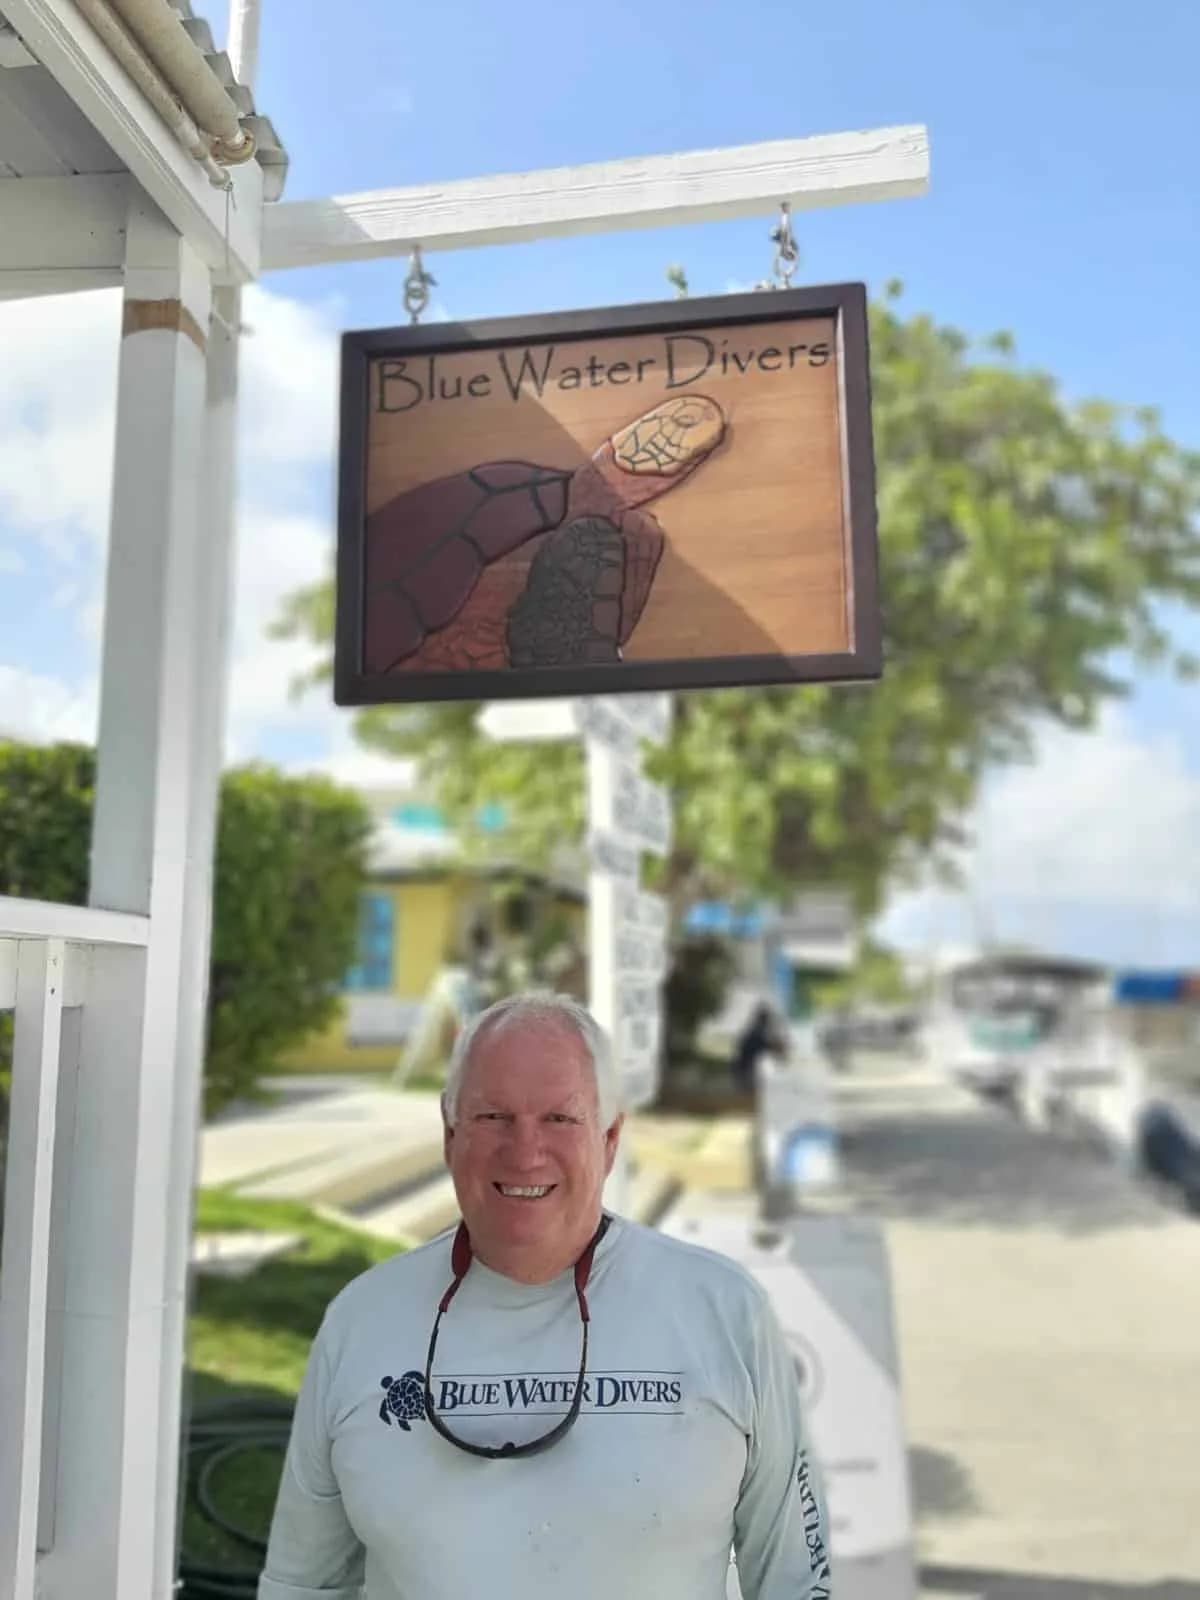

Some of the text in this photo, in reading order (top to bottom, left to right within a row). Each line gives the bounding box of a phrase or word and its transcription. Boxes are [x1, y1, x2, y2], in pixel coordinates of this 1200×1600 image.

[375, 335, 829, 413] Blue Water Divers
[437, 1377, 681, 1409] BLUE WATER DIVERS
